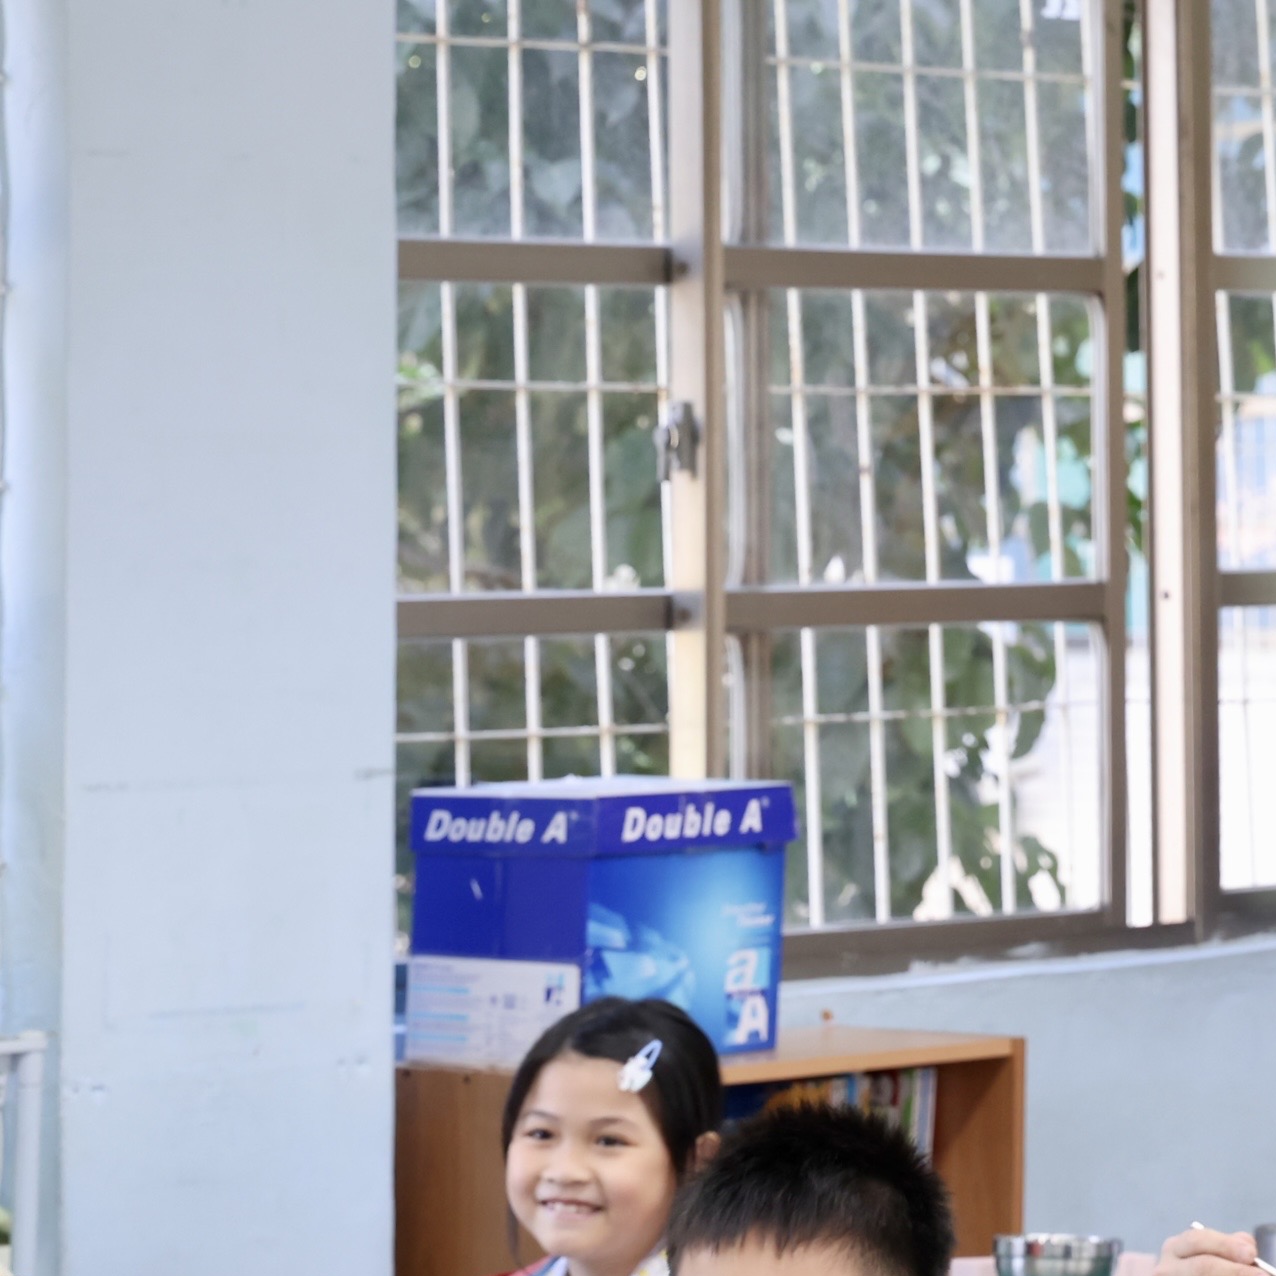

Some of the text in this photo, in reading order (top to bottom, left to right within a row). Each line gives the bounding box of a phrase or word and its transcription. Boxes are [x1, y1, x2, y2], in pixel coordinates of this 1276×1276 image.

[424, 809, 568, 844] Double A
[622, 797, 763, 842] Double A
